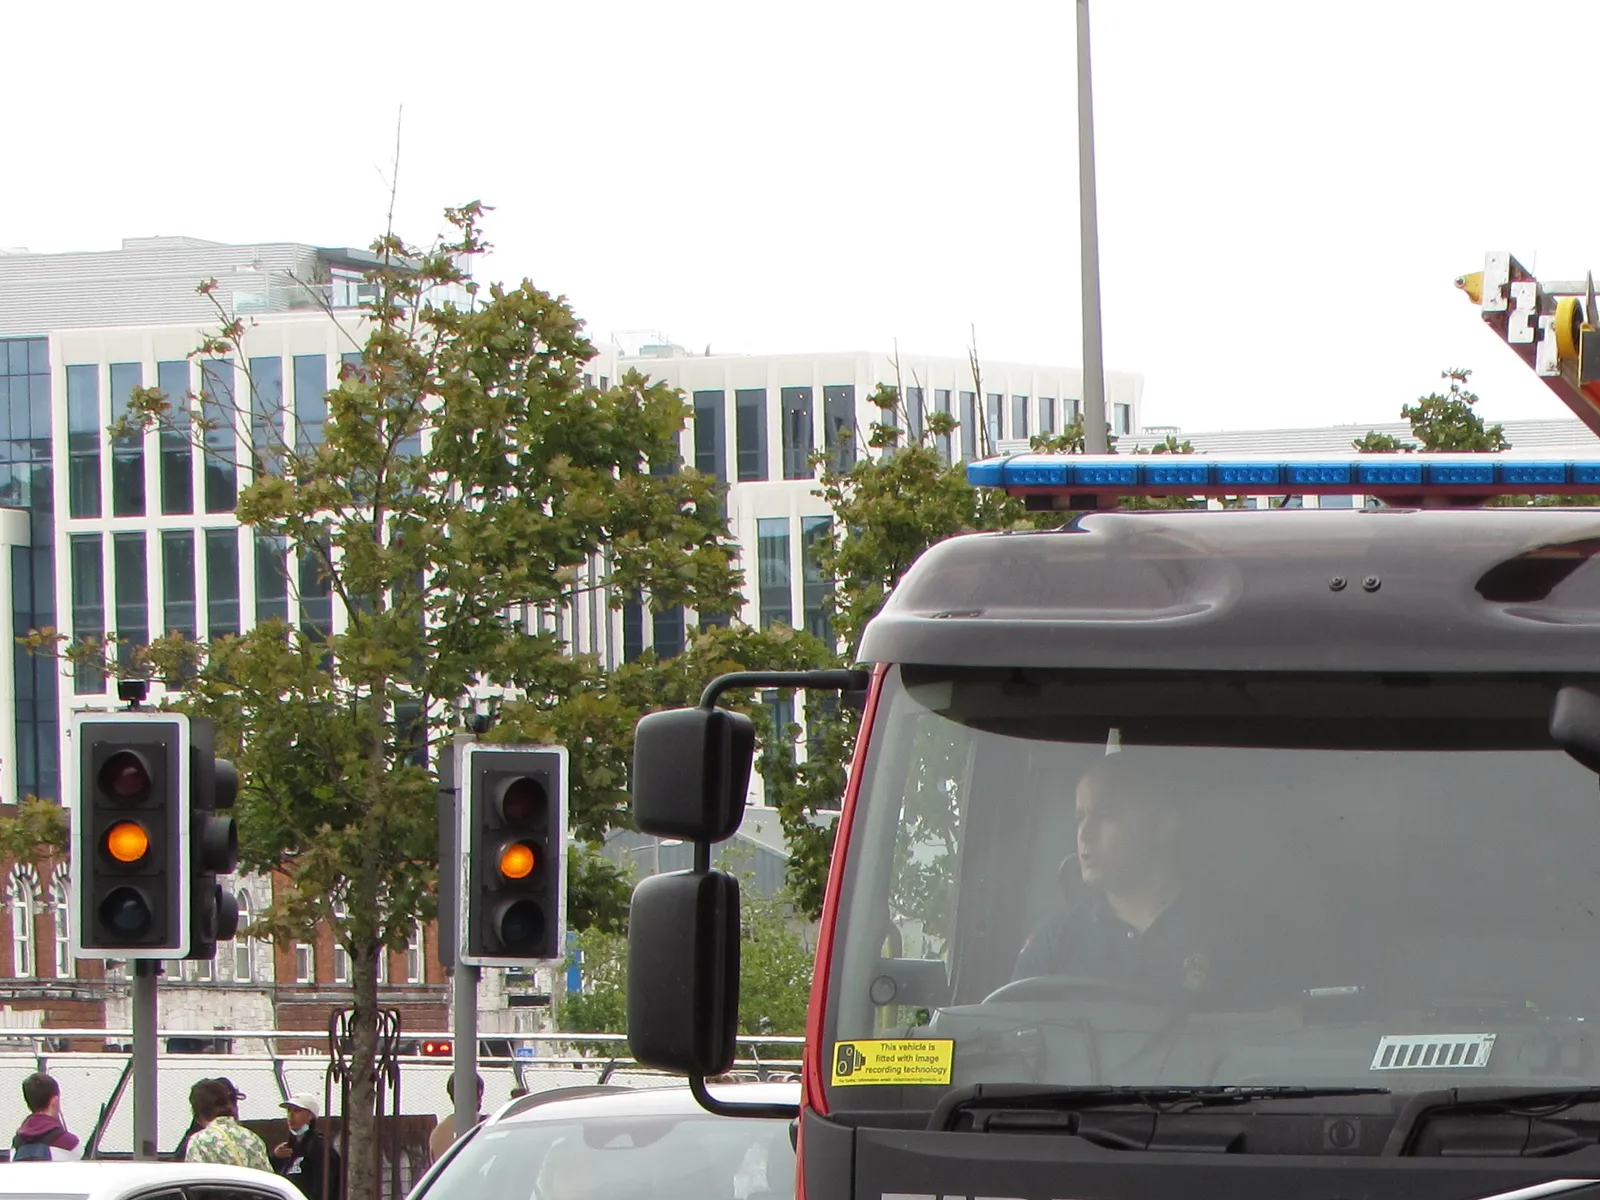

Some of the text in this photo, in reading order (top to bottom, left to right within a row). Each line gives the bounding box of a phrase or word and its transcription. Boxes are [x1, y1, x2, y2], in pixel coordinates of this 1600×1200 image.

[880, 1043, 936, 1051] This vehicle is
[875, 1054, 895, 1063] fitted
[897, 1054, 914, 1063] with
[864, 1064, 948, 1075] recording technology
